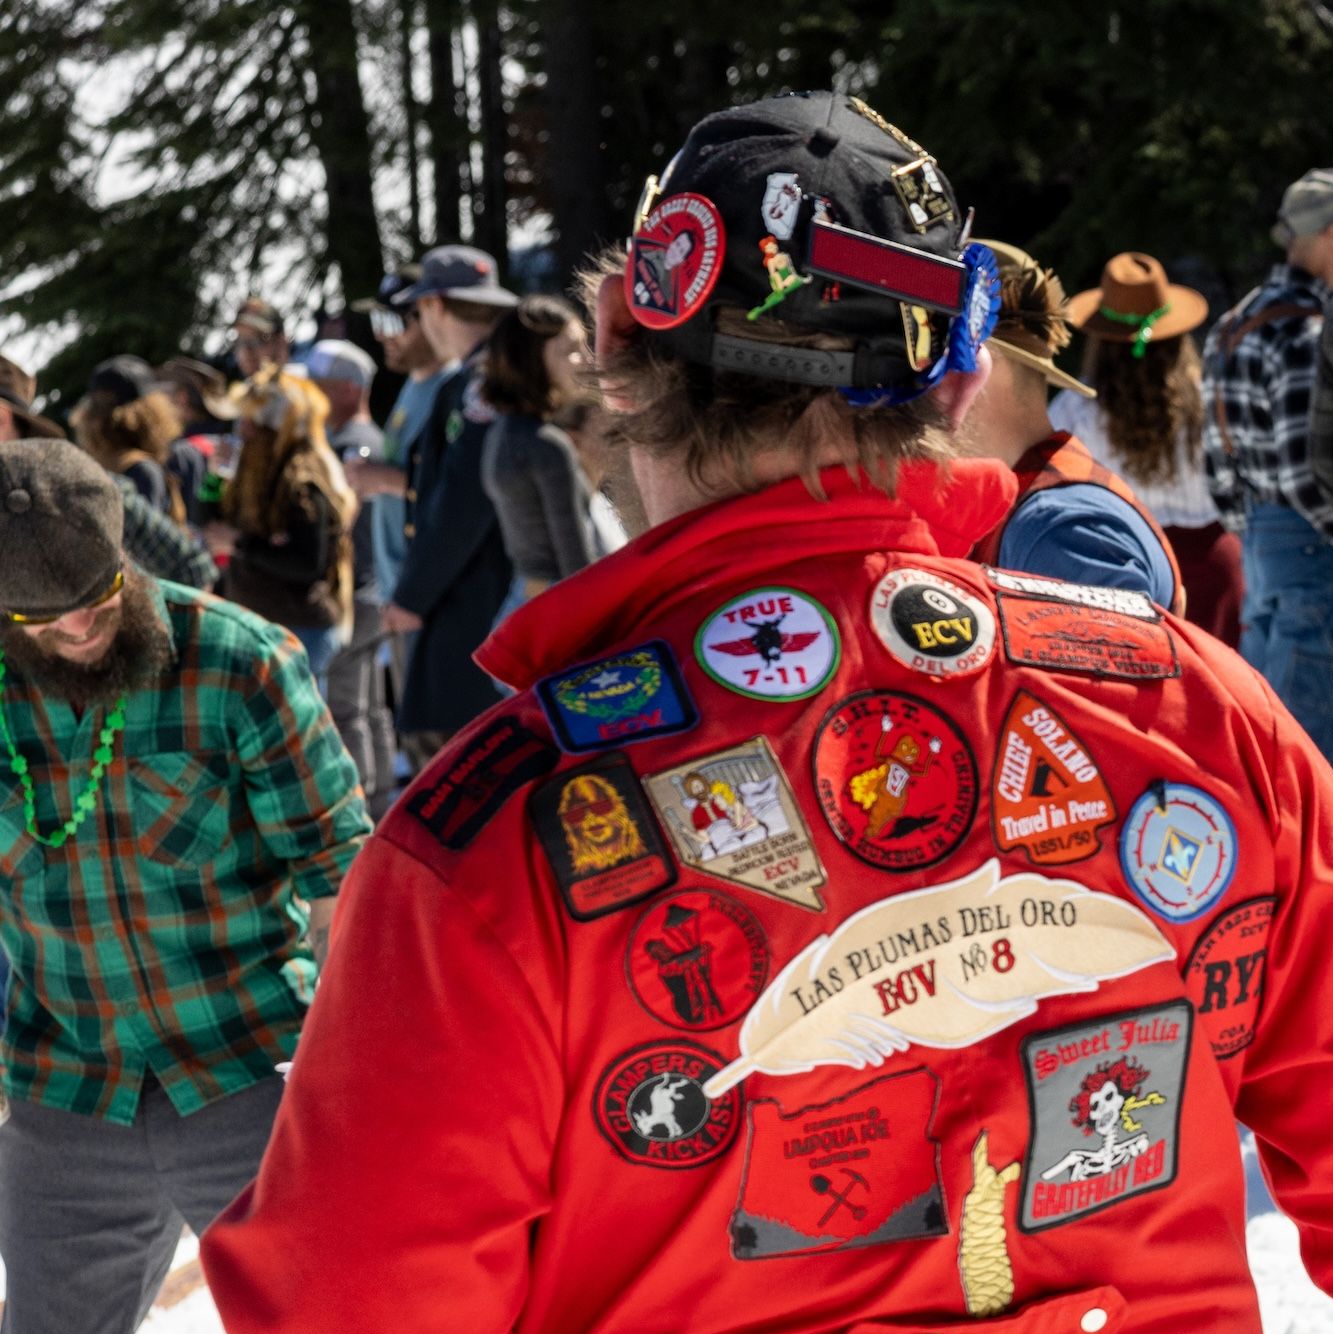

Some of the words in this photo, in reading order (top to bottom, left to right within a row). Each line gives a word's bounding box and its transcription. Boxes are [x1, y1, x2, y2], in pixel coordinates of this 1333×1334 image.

[722, 596, 794, 624] TRUE
[911, 617, 973, 649] ECV
[742, 666, 807, 686] 7-11
[911, 654, 952, 675] DEL
[956, 644, 987, 671] ORO
[998, 731, 1033, 804] CHIEF
[1021, 707, 1100, 784] SOLANO
[1001, 804, 1049, 841] Travel
[1049, 803, 1067, 828] in
[1067, 799, 1109, 825] Peace
[763, 856, 799, 881] ECV
[790, 965, 845, 1018] LAS
[846, 916, 952, 978] PLUMAS
[958, 903, 1012, 939] DEL
[1020, 897, 1077, 928] ORO
[873, 959, 937, 1017] ECV
[992, 937, 1016, 974] 8
[1198, 948, 1268, 1014] RY
[1034, 1027, 1112, 1082] Sweet
[1116, 1015, 1180, 1051] Julia
[608, 1054, 704, 1132] CLAMPERS
[647, 1131, 713, 1159] KICK
[704, 1091, 733, 1143] ASS
[1031, 1164, 1131, 1220] GRATEFULLY
